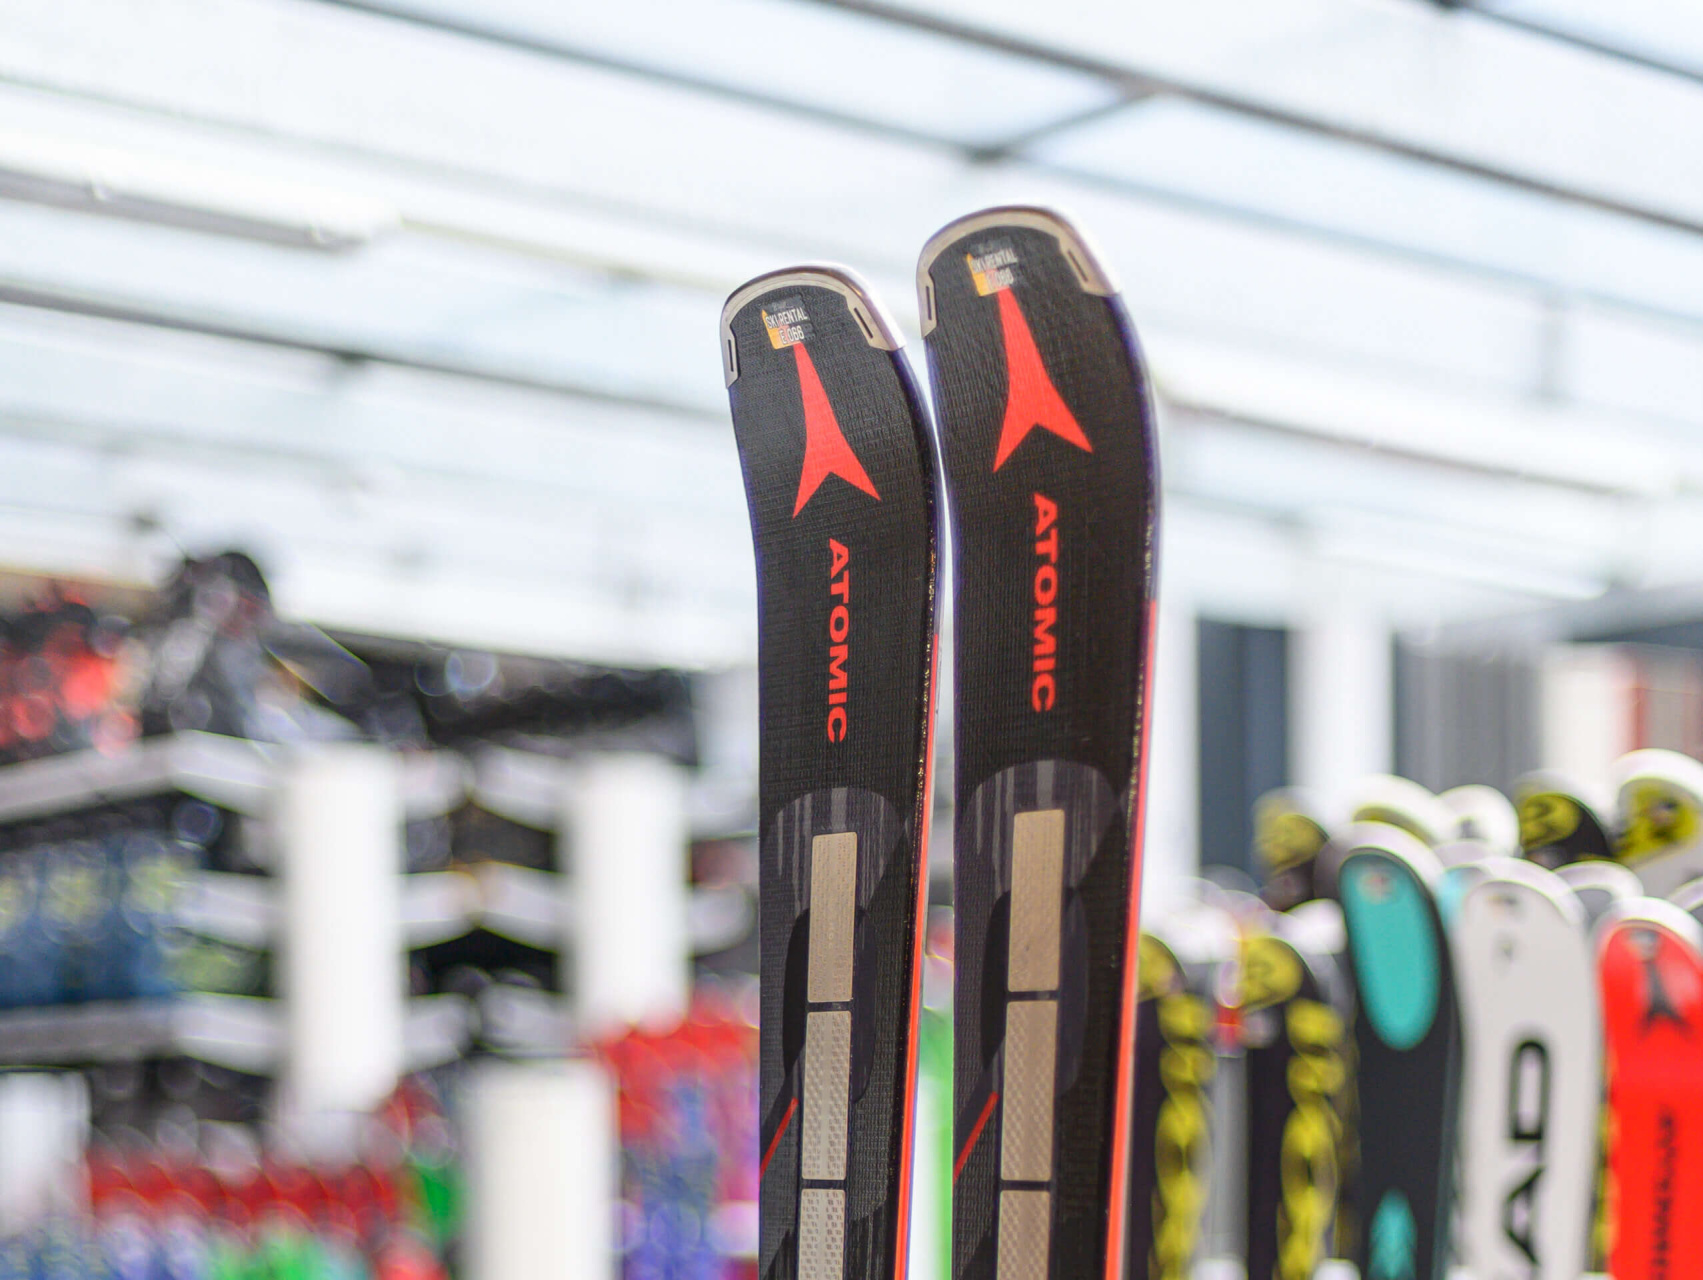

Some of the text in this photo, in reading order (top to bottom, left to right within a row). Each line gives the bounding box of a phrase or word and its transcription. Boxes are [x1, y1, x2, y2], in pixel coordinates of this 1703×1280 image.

[766, 307, 808, 328] SKI RENTAL
[828, 538, 849, 743] ATOMIC
[1032, 492, 1058, 713] ATOMIC
